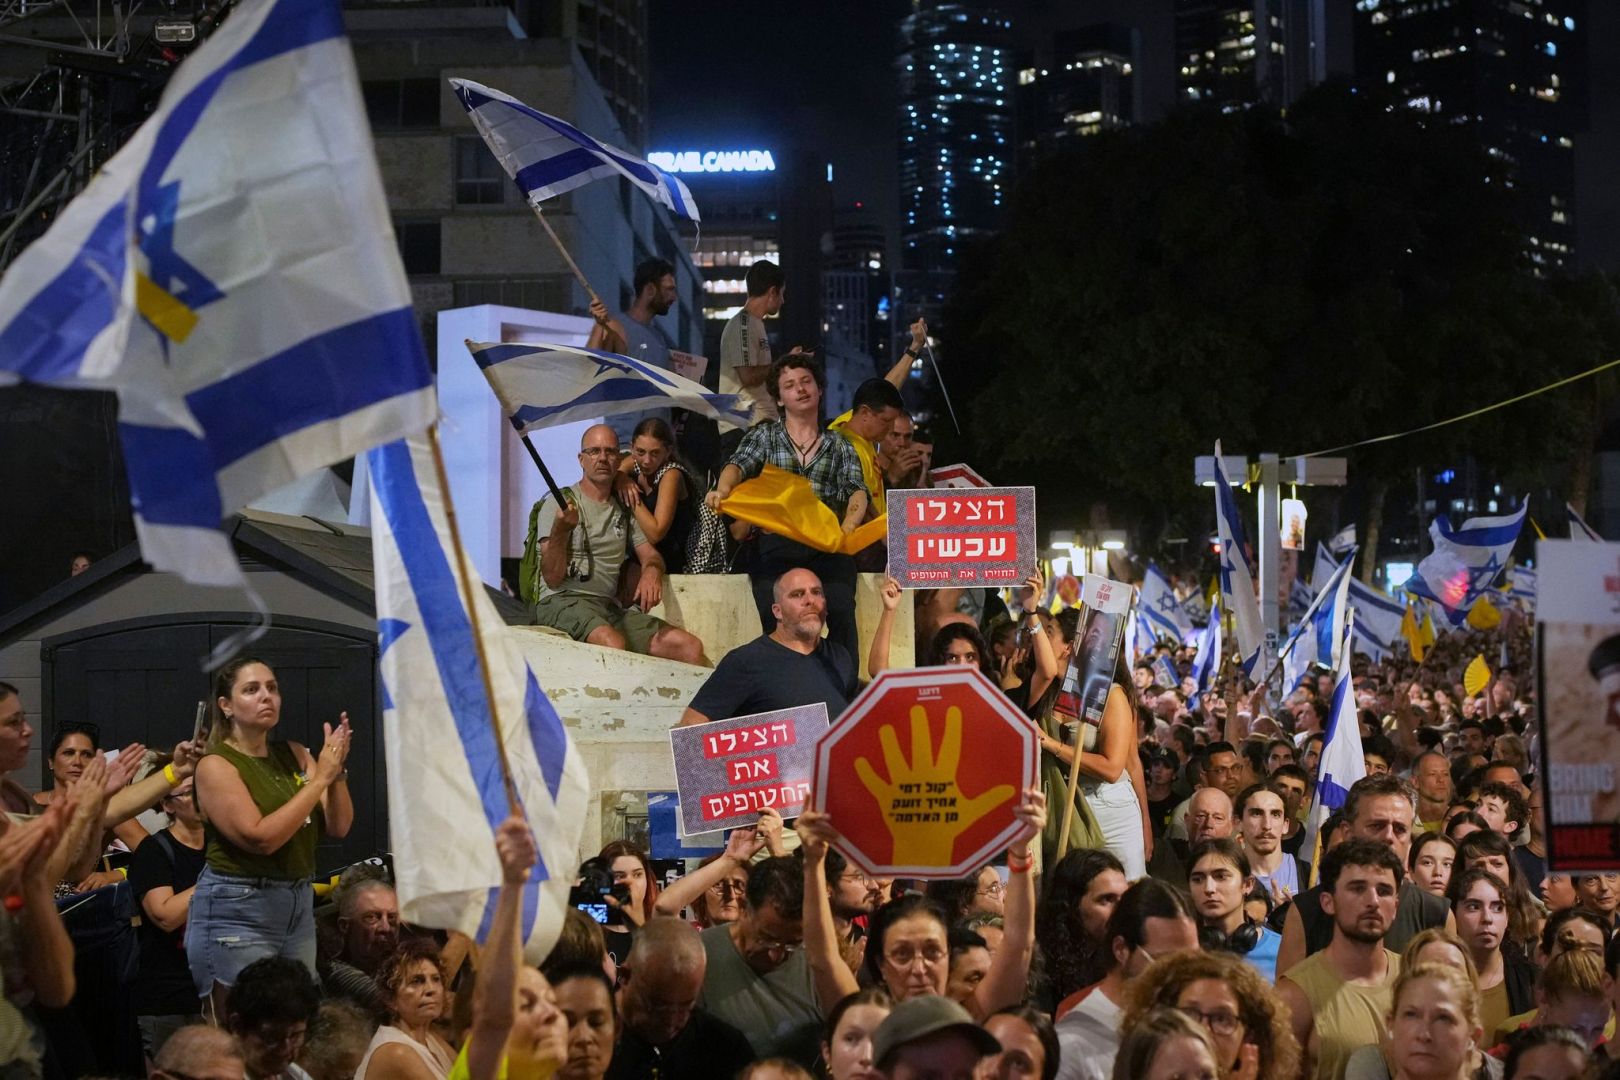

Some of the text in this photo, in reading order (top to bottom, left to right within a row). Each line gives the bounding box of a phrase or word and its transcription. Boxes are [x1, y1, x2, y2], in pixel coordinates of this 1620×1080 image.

[703, 150, 776, 172] CANADA
[916, 499, 1005, 522] הצילו
[917, 537, 1006, 558] עכשיו
[910, 569, 1015, 580] החזירו את החטופים
[709, 723, 788, 754] הצילו
[734, 758, 770, 781] את
[899, 783, 921, 793] דמי
[708, 782, 811, 817] החטופים
[926, 797, 957, 809] אחיך
[945, 812, 959, 823] מן
